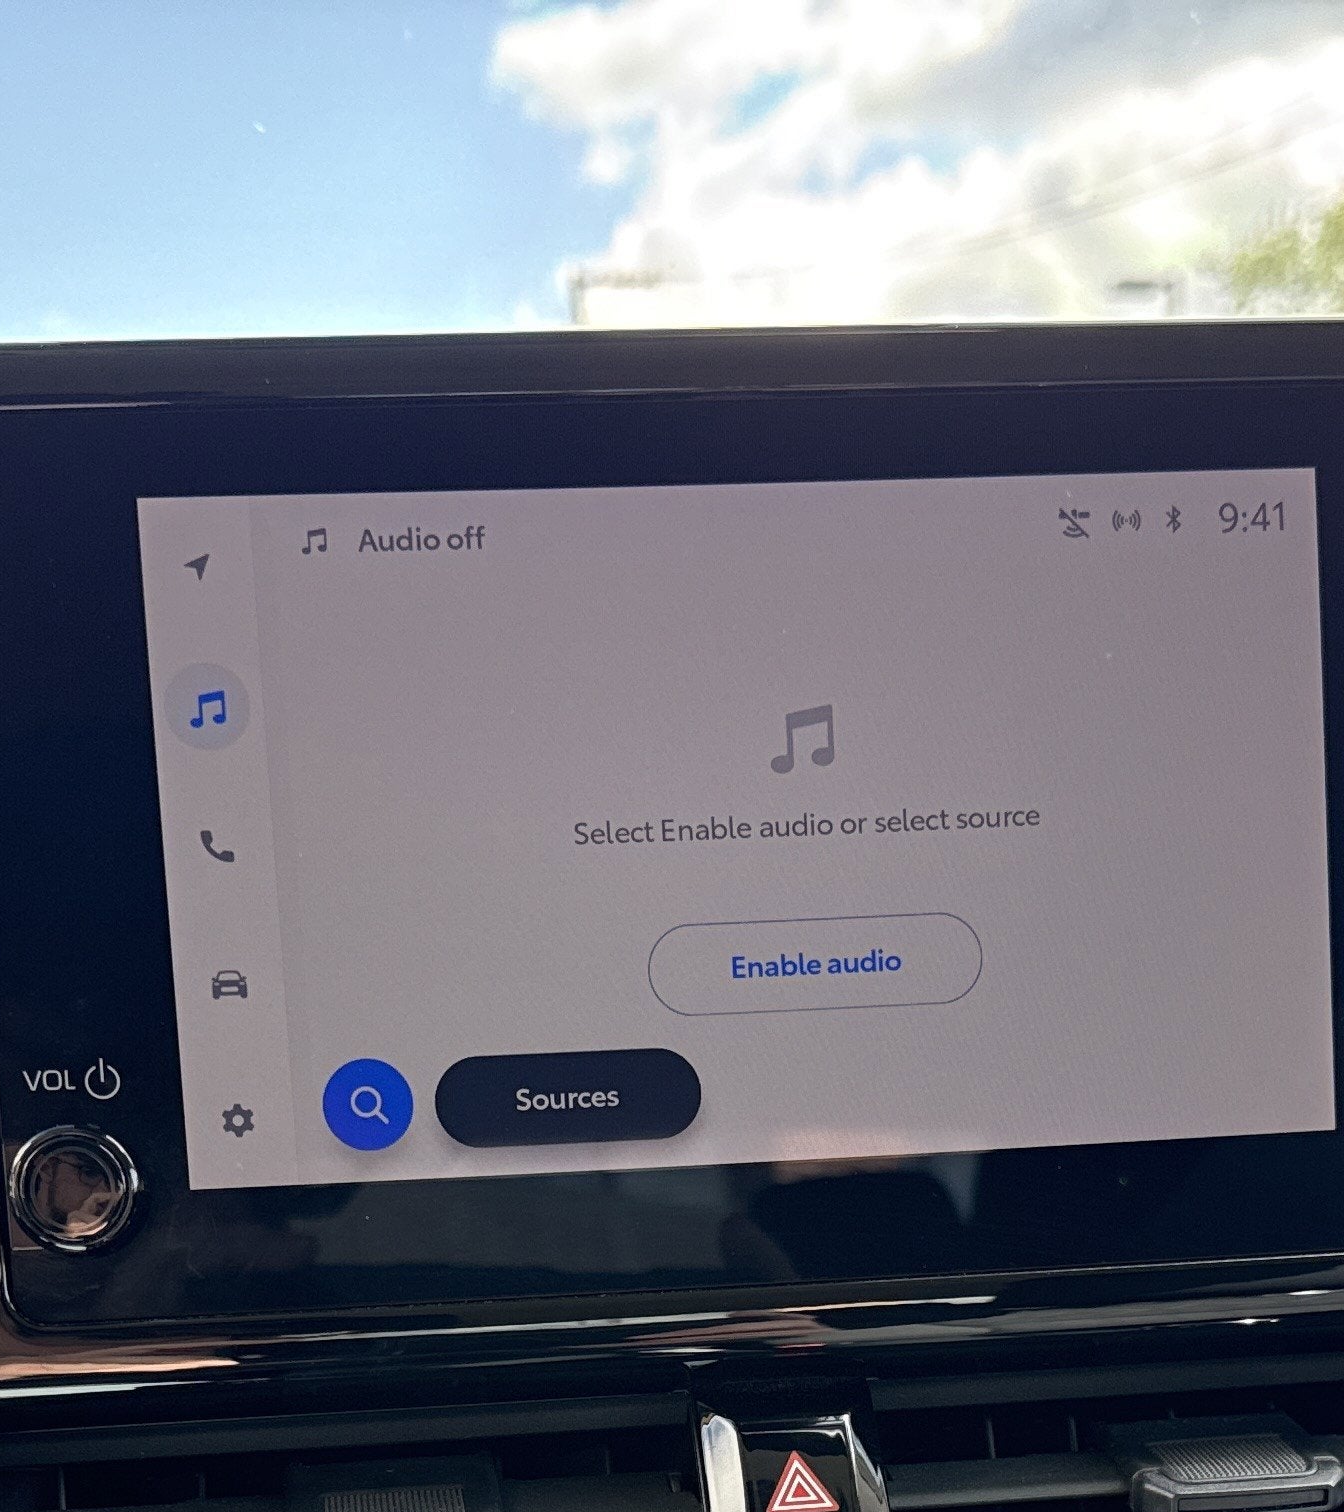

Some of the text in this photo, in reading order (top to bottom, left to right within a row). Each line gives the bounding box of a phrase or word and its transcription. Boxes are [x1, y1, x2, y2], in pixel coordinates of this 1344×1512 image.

[1217, 500, 1287, 535] 9:41
[357, 524, 486, 554] Audio off
[573, 807, 1041, 847] Select Enable audio or select source
[730, 947, 903, 980] Enable audio
[22, 1069, 77, 1092] VOL
[515, 1087, 621, 1112] Sources
